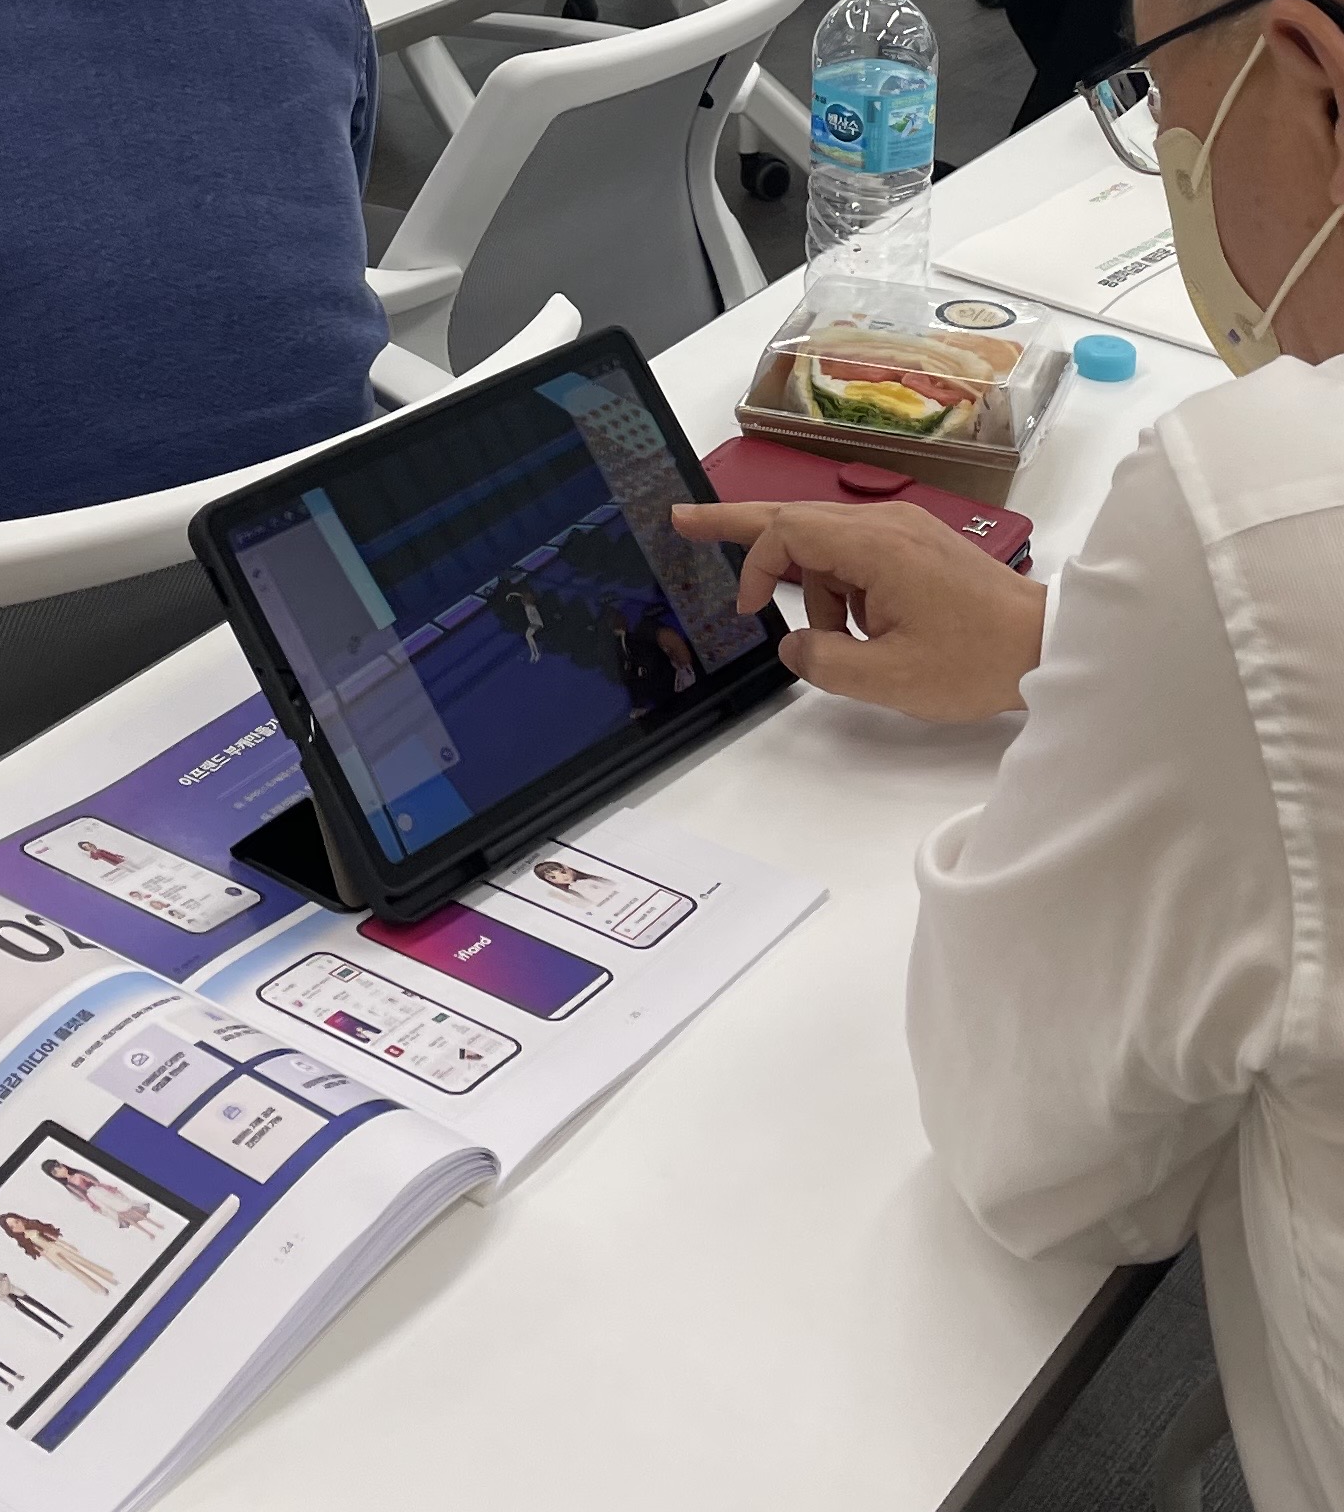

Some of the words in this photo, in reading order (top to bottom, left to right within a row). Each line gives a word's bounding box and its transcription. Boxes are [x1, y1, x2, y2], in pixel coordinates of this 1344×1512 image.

[827, 112, 860, 136] 백산수
[178, 754, 231, 786] 이프랜드
[452, 935, 493, 963] ifland
[17, 1038, 60, 1075] 미디어
